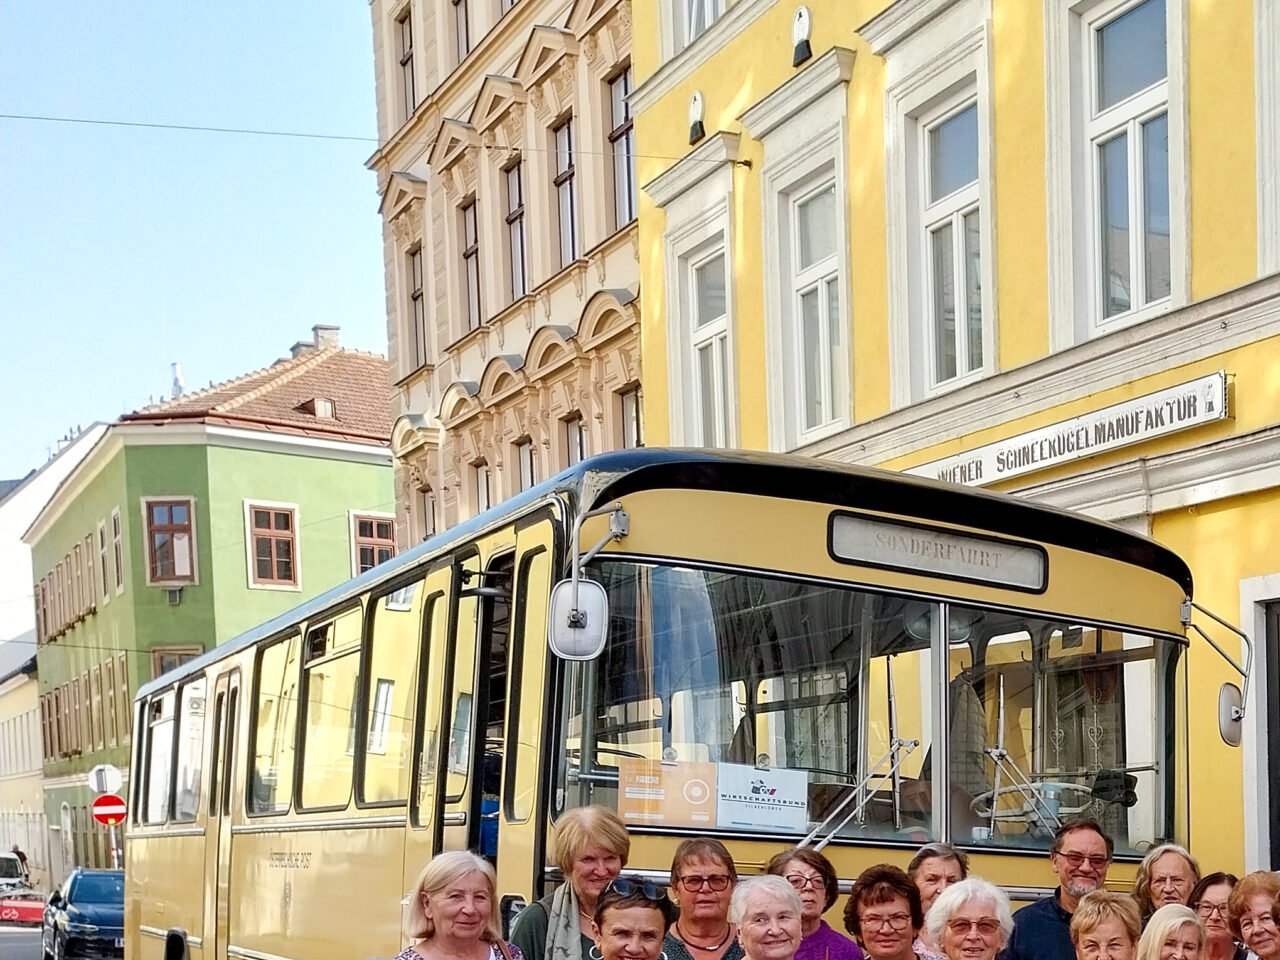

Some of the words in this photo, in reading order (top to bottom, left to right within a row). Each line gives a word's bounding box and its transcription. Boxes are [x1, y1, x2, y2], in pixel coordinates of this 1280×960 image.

[937, 459, 983, 484] WIENER
[996, 394, 1198, 472] SCHNEEKUGELMANUFAKTUR
[875, 531, 1002, 568] SONDERFAHRT
[721, 793, 806, 806] WIRTSCHAFTSBUND
